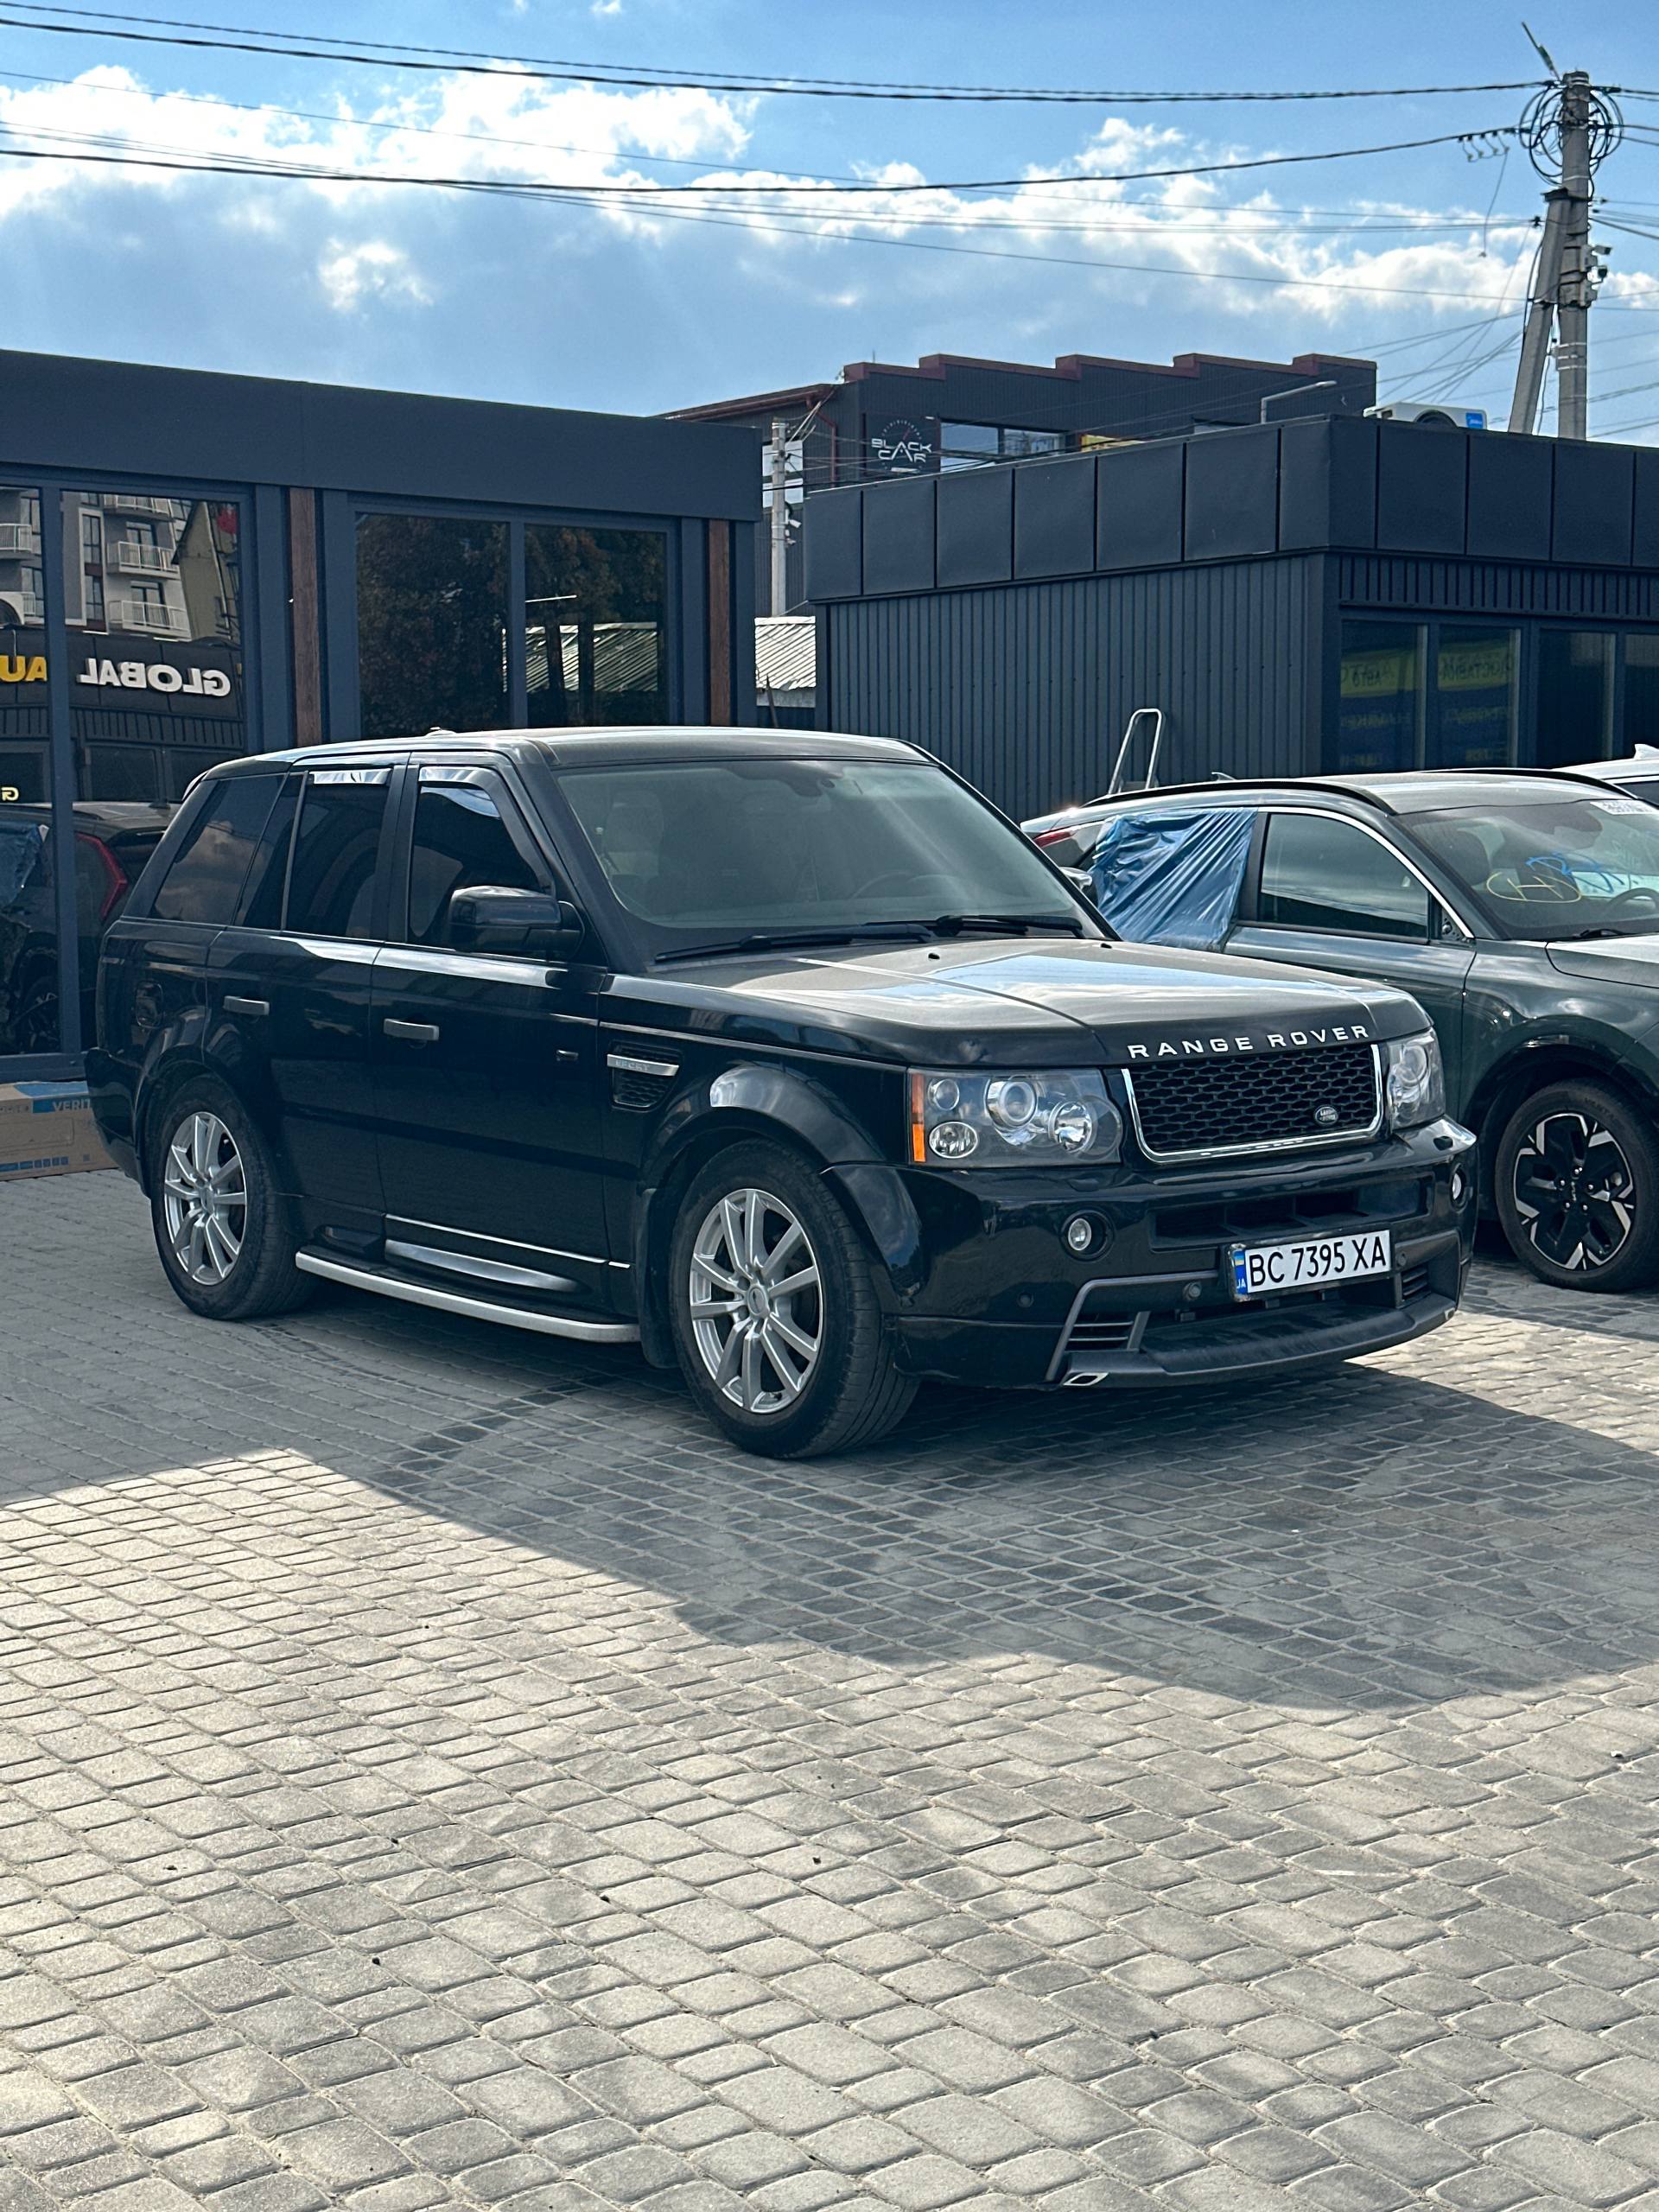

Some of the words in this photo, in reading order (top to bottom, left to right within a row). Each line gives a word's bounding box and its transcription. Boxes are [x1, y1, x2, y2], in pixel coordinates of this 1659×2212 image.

[871, 437, 932, 454] BLACK
[1127, 1036, 1254, 1059] RANGE
[1267, 1025, 1370, 1048] ROVER
[1249, 1251, 1285, 1287] BC
[1291, 1242, 1345, 1281] 7395
[1351, 1236, 1387, 1271] XA
